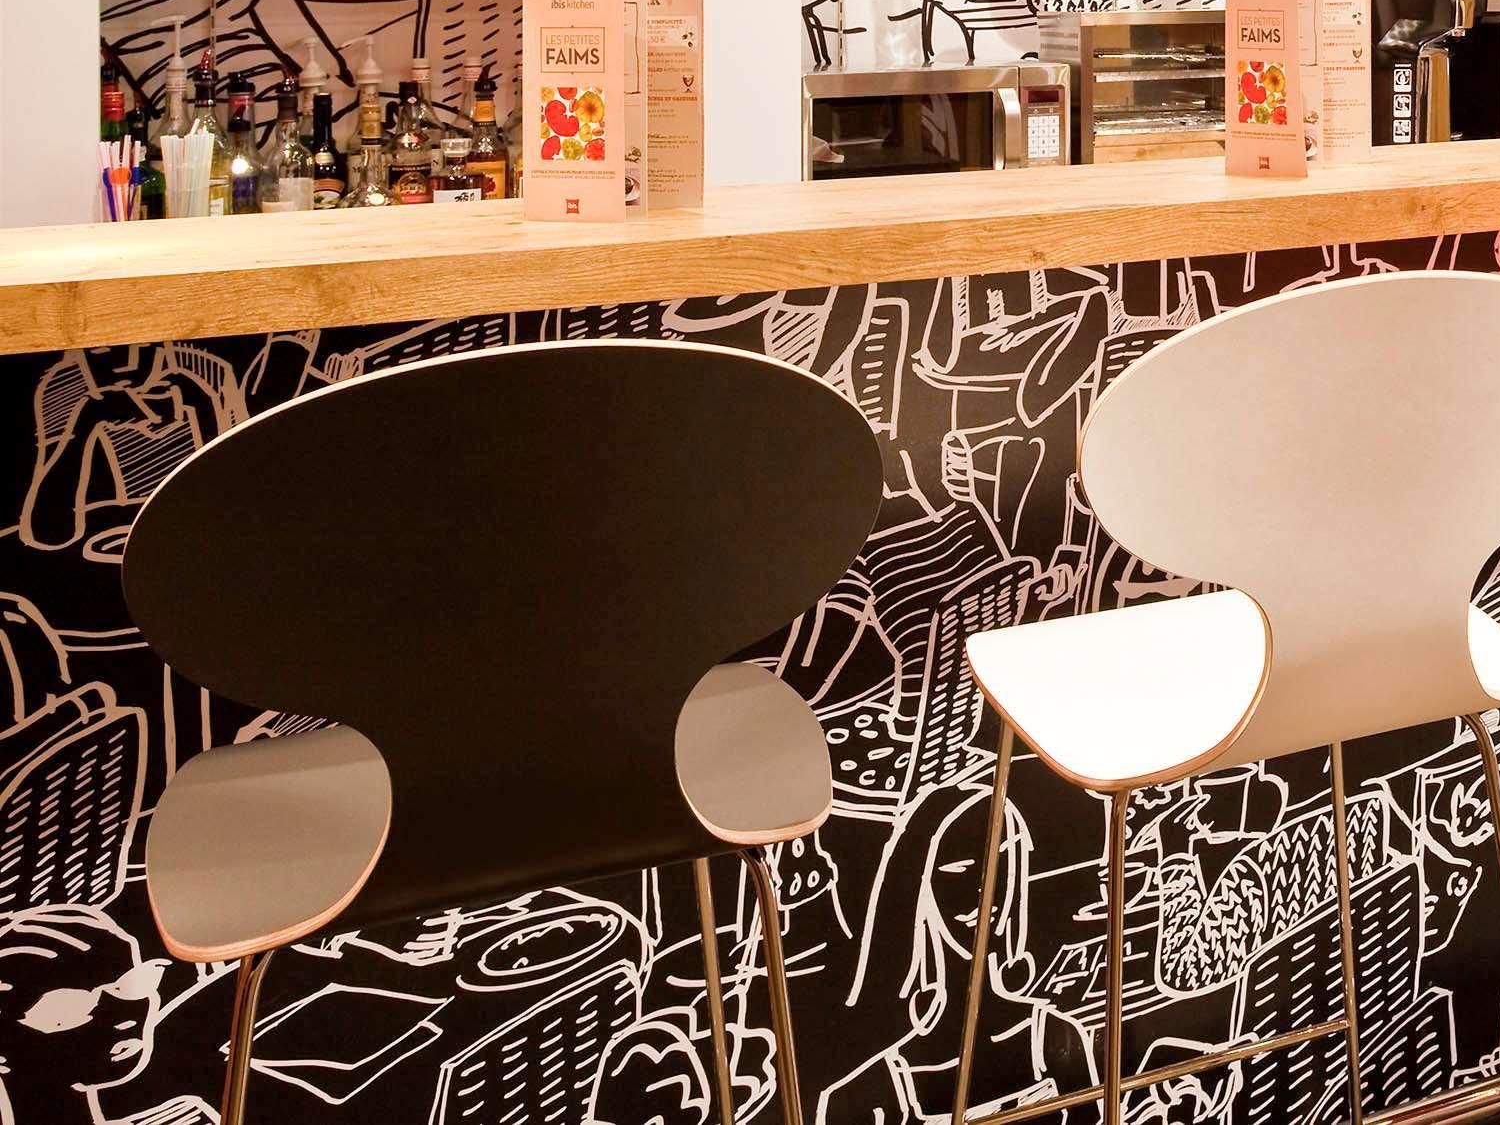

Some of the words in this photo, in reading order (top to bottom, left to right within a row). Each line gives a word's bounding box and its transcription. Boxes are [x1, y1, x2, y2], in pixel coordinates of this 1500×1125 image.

[551, 0, 566, 9] ibis
[567, 0, 595, 9] kitchen
[546, 34, 562, 45] LES
[563, 34, 600, 45] PETITES
[1240, 27, 1281, 43] FAIMS
[545, 47, 600, 65] FAIMS
